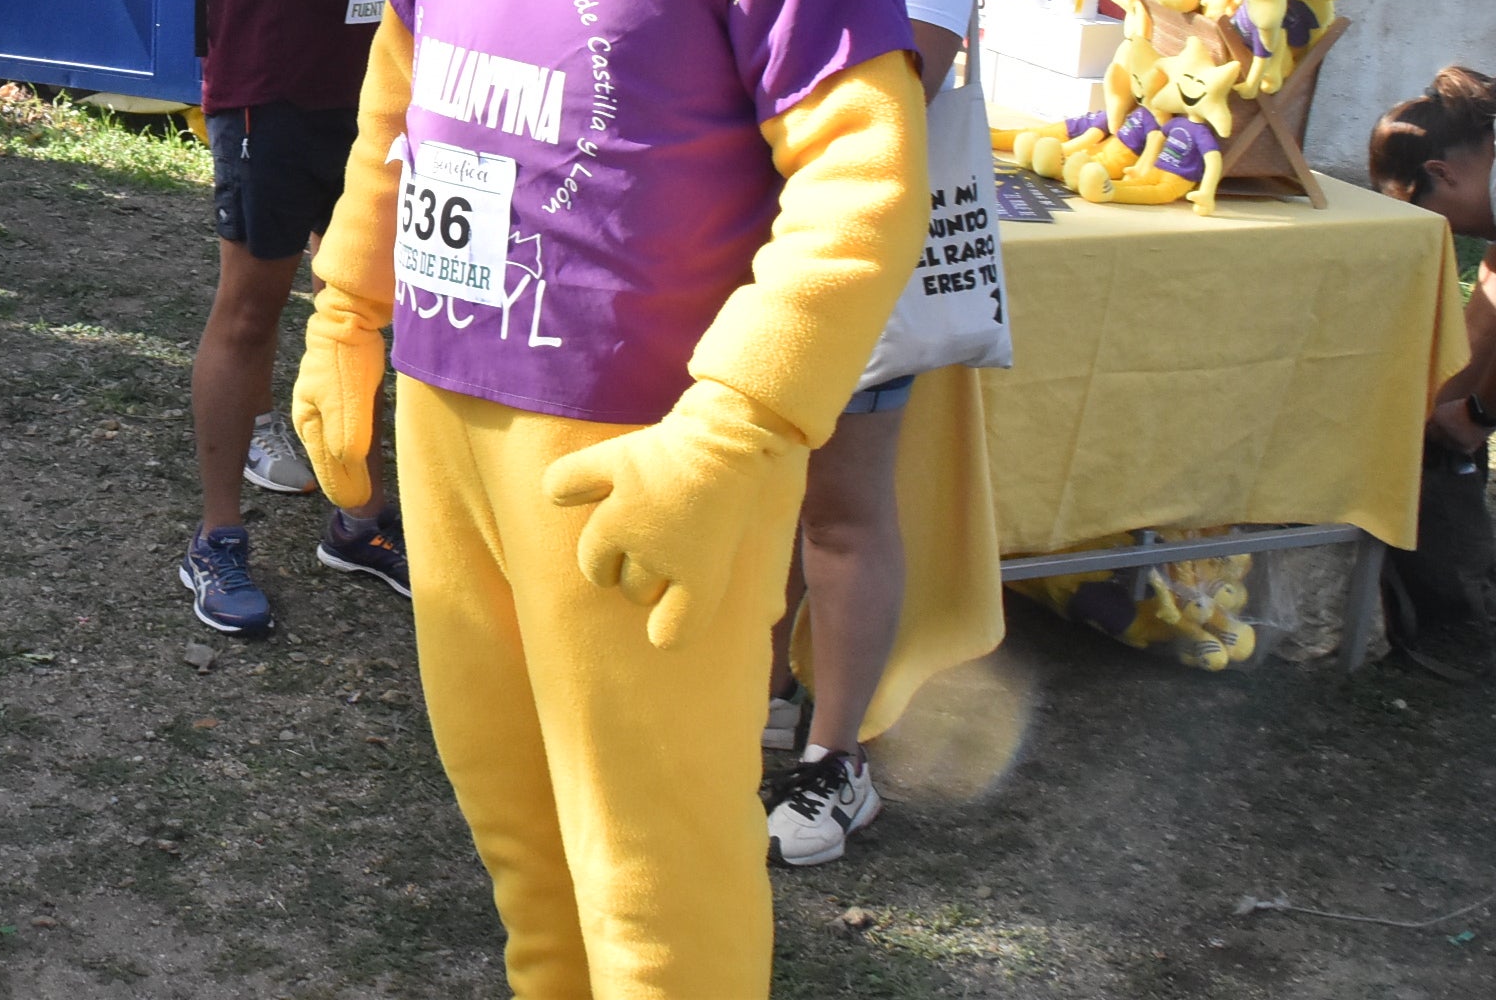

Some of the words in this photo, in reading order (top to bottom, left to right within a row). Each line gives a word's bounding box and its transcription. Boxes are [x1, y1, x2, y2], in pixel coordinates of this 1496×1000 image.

[587, 36, 618, 132] Castilla
[577, 137, 599, 158] y
[541, 162, 593, 215] León
[402, 182, 474, 250] 536
[419, 249, 436, 278] DE
[438, 254, 492, 292] BÉJAR
[943, 234, 995, 266] RARO
[923, 269, 977, 296] ERES
